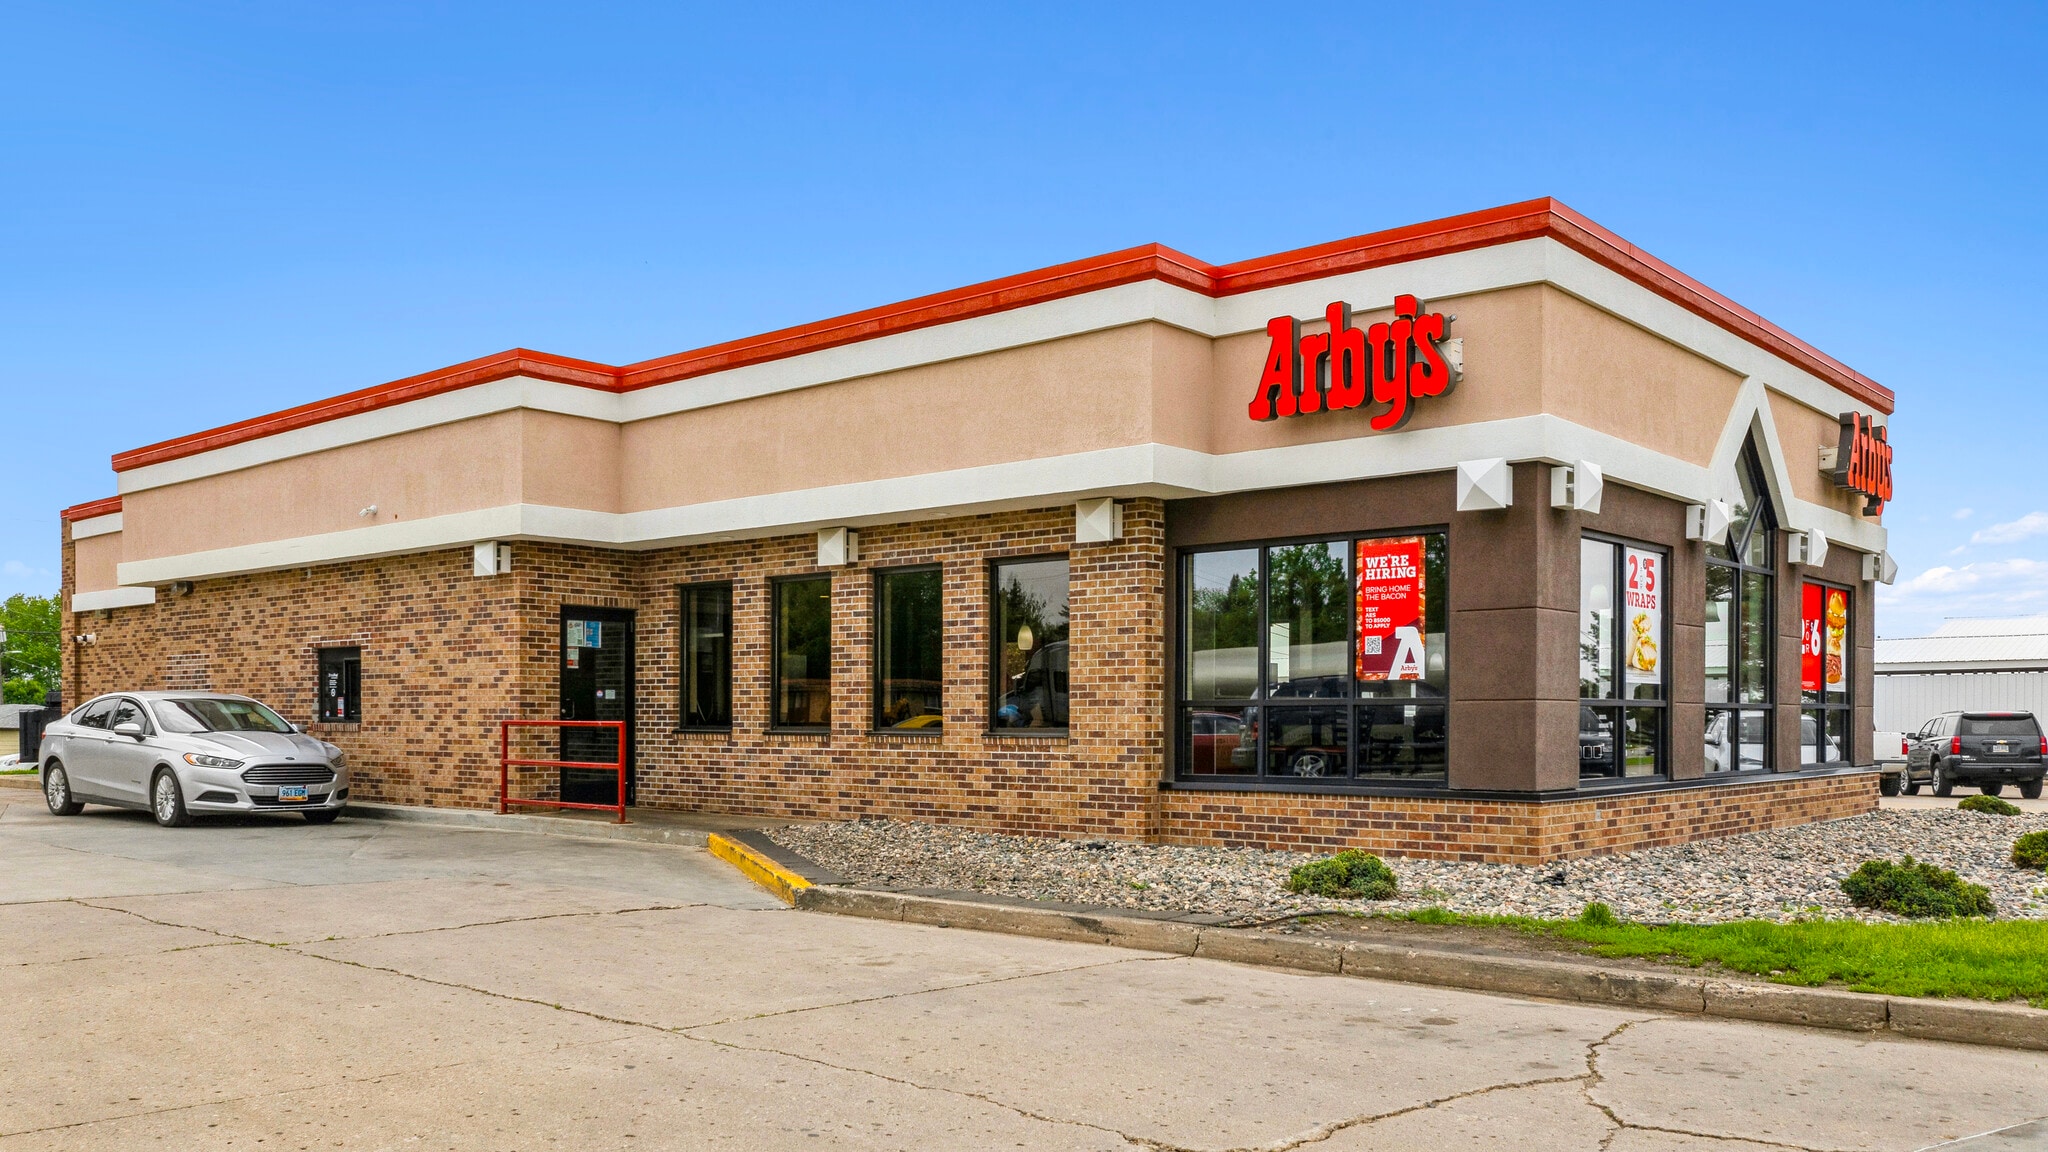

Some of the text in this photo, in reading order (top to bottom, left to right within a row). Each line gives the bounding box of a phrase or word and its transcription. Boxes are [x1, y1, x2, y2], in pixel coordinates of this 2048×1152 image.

[1248, 294, 1451, 431] Arby's
[1847, 411, 1893, 516] Arby's
[1365, 554, 1409, 568] WE'RE
[1365, 566, 1416, 580] HIRING
[1628, 555, 1638, 589] 2
[1626, 591, 1656, 609] WRAPS
